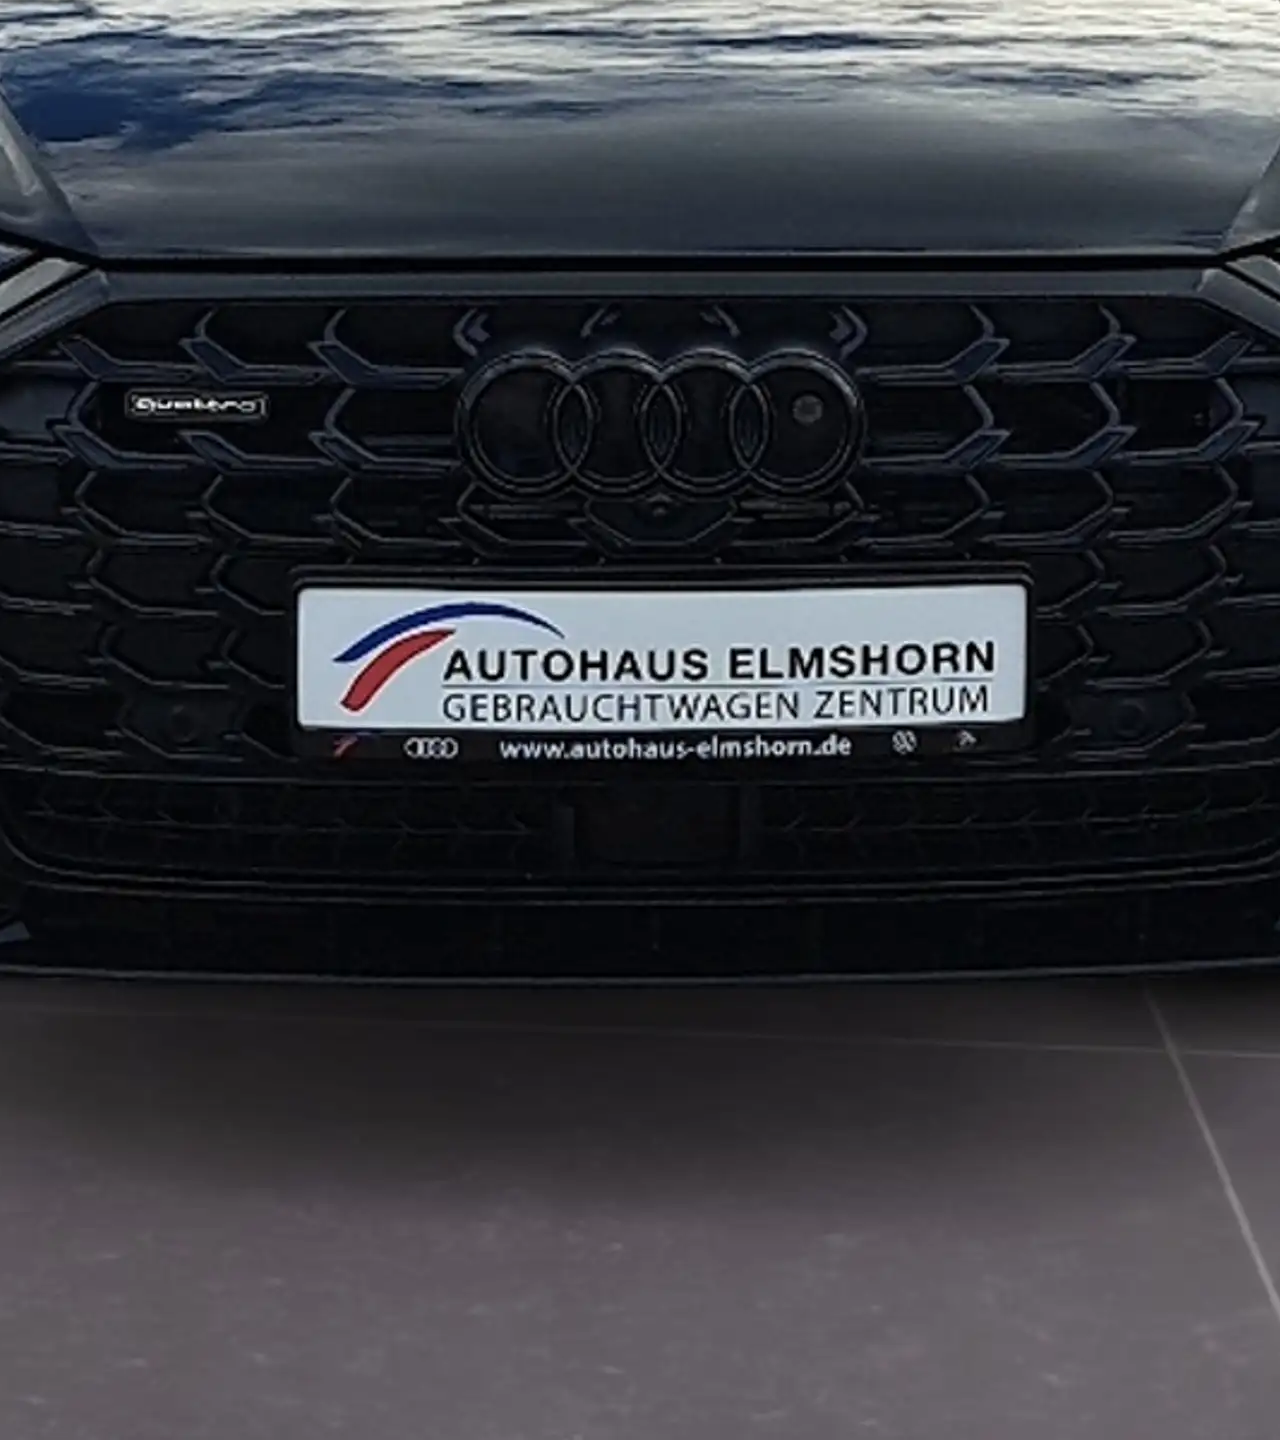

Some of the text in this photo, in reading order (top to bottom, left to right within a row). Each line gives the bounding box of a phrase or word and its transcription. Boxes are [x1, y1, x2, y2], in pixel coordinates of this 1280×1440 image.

[443, 641, 995, 681] AUTOHAUS ELMSHORN
[442, 686, 988, 722] GEBRAUCHTWAGEN ZENTRUM
[499, 736, 852, 760] www.autohaus-elmshorn.de
